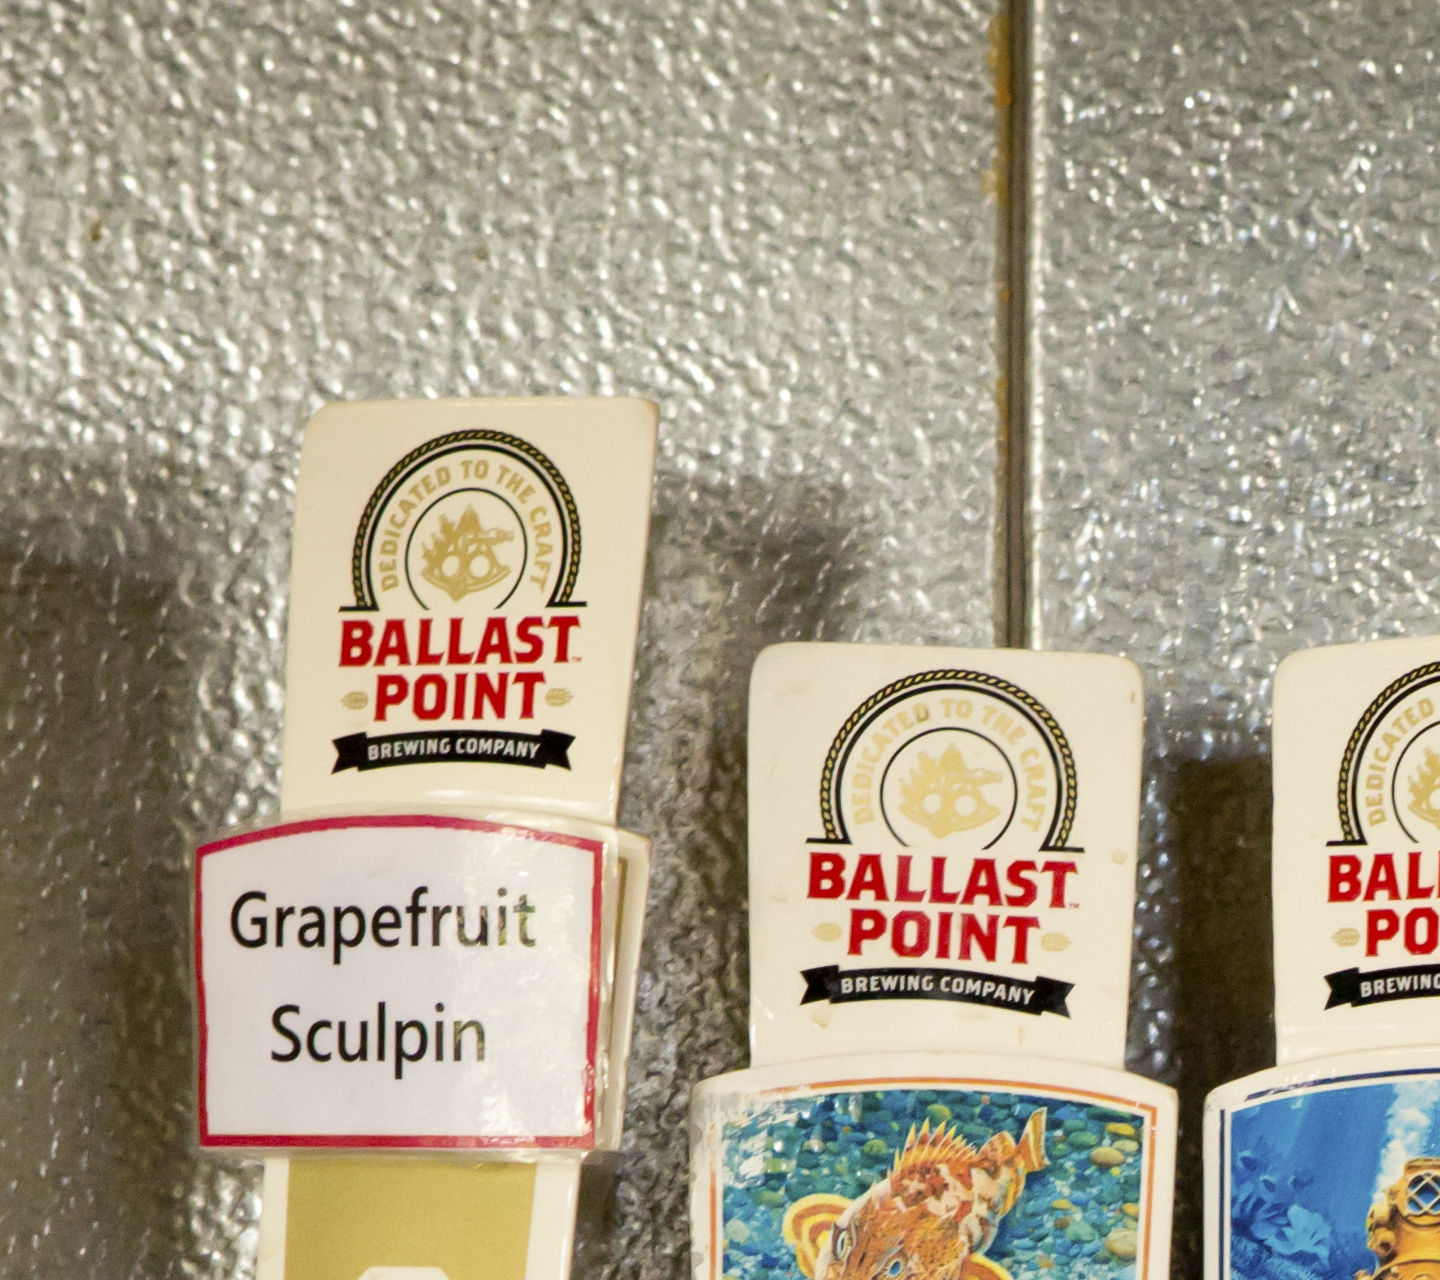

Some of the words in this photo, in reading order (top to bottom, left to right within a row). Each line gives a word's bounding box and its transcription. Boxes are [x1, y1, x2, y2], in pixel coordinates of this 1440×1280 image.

[380, 466, 451, 592] DEDICATED
[461, 460, 489, 479] TO
[497, 465, 536, 504] THE
[530, 505, 553, 594] CRAFT
[339, 615, 581, 667] BALLAST
[374, 672, 546, 722] POINT
[367, 738, 451, 760] BREWING
[456, 738, 541, 758] COMPANY
[851, 703, 929, 826] DEDICATED
[941, 699, 972, 719] TO
[981, 705, 1027, 745] THE
[1021, 748, 1047, 832] CRAFT
[1366, 699, 1434, 826] DEDICATED
[807, 852, 1078, 908] BALLAST
[230, 886, 536, 965] Grapefruit
[847, 908, 1041, 964] POINT
[841, 975, 933, 994] BREWING
[940, 977, 1035, 1005] COMPANY
[271, 1001, 486, 1080] Sculpin
